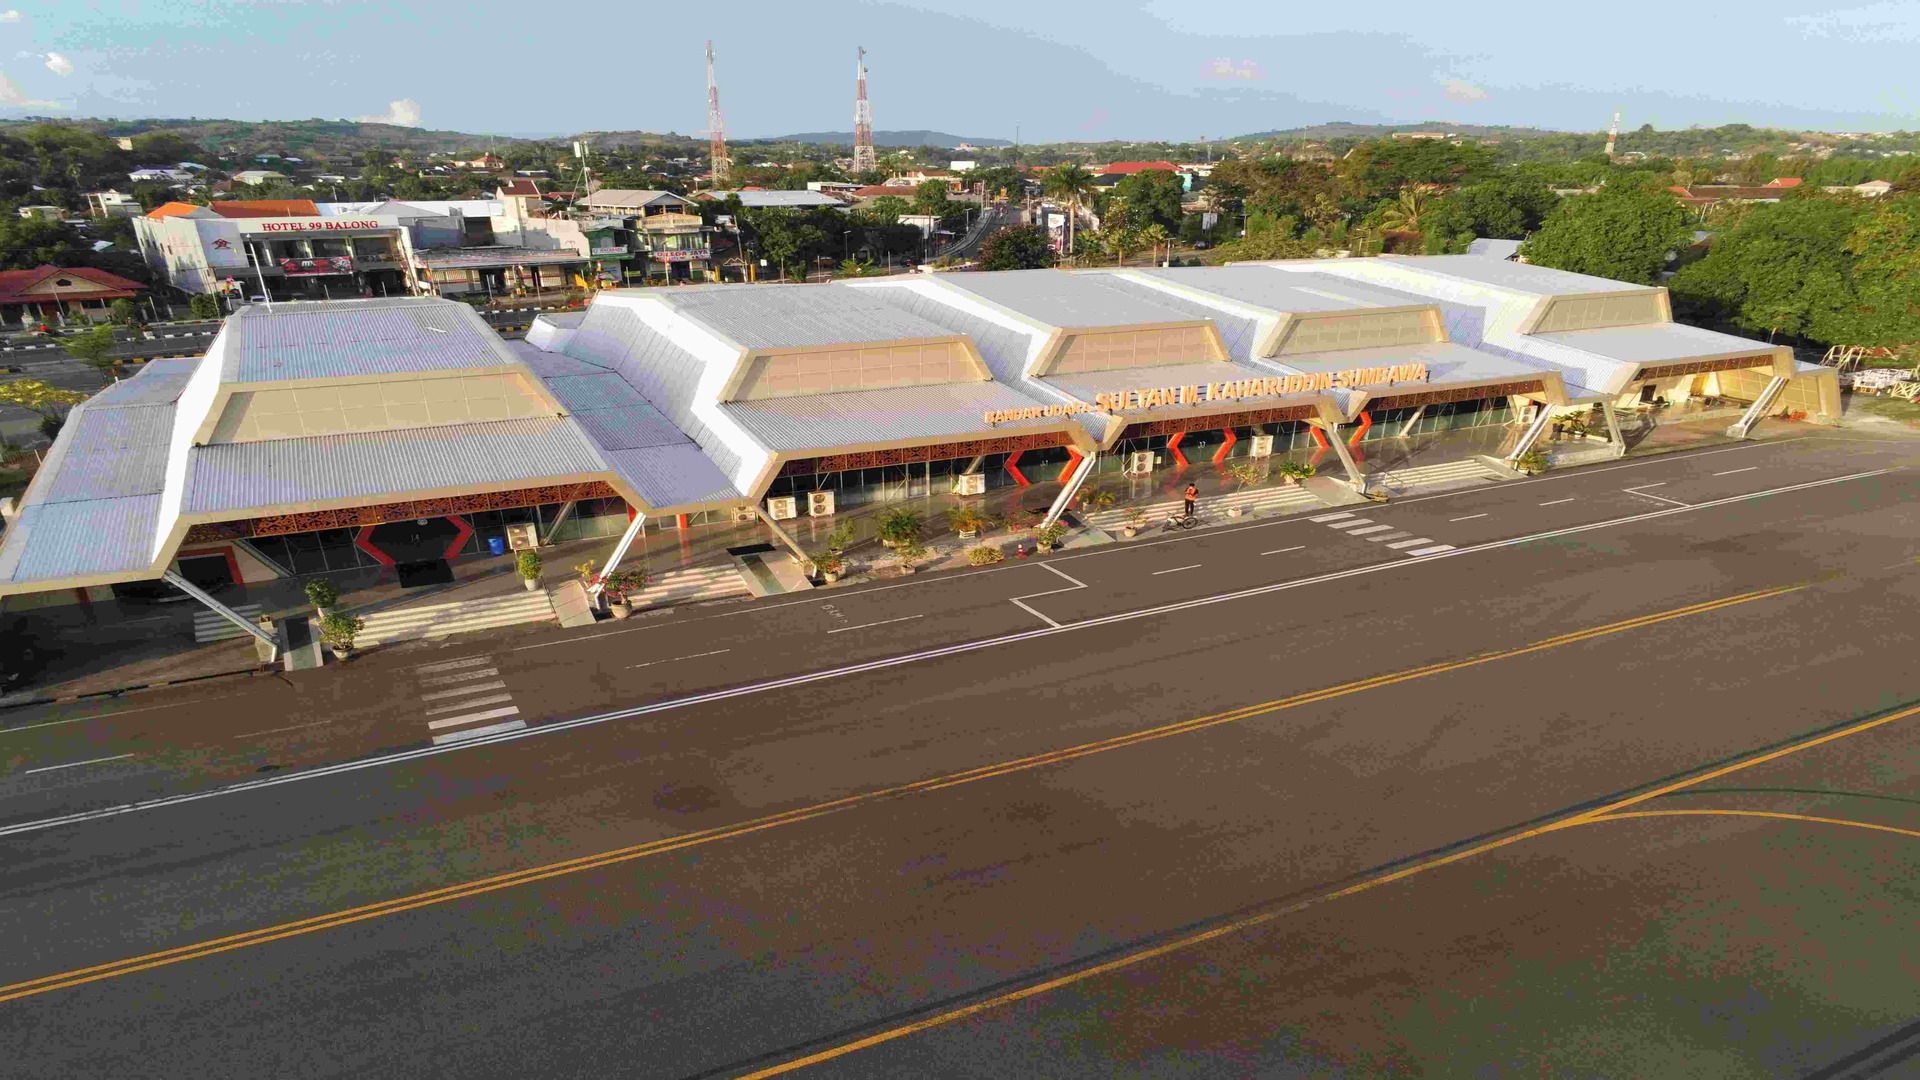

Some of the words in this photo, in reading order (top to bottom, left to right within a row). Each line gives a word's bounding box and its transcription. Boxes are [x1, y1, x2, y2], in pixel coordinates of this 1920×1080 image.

[262, 222, 306, 232] HOTEL
[309, 221, 322, 230] 99
[325, 220, 378, 230] BALONG
[1096, 386, 1175, 412] SULTAN
[1206, 372, 1333, 401] KAHARUDDIN
[1336, 363, 1427, 388] SUMBAWA
[985, 407, 1042, 423] BANDAR
[1044, 402, 1091, 417] UDARA
